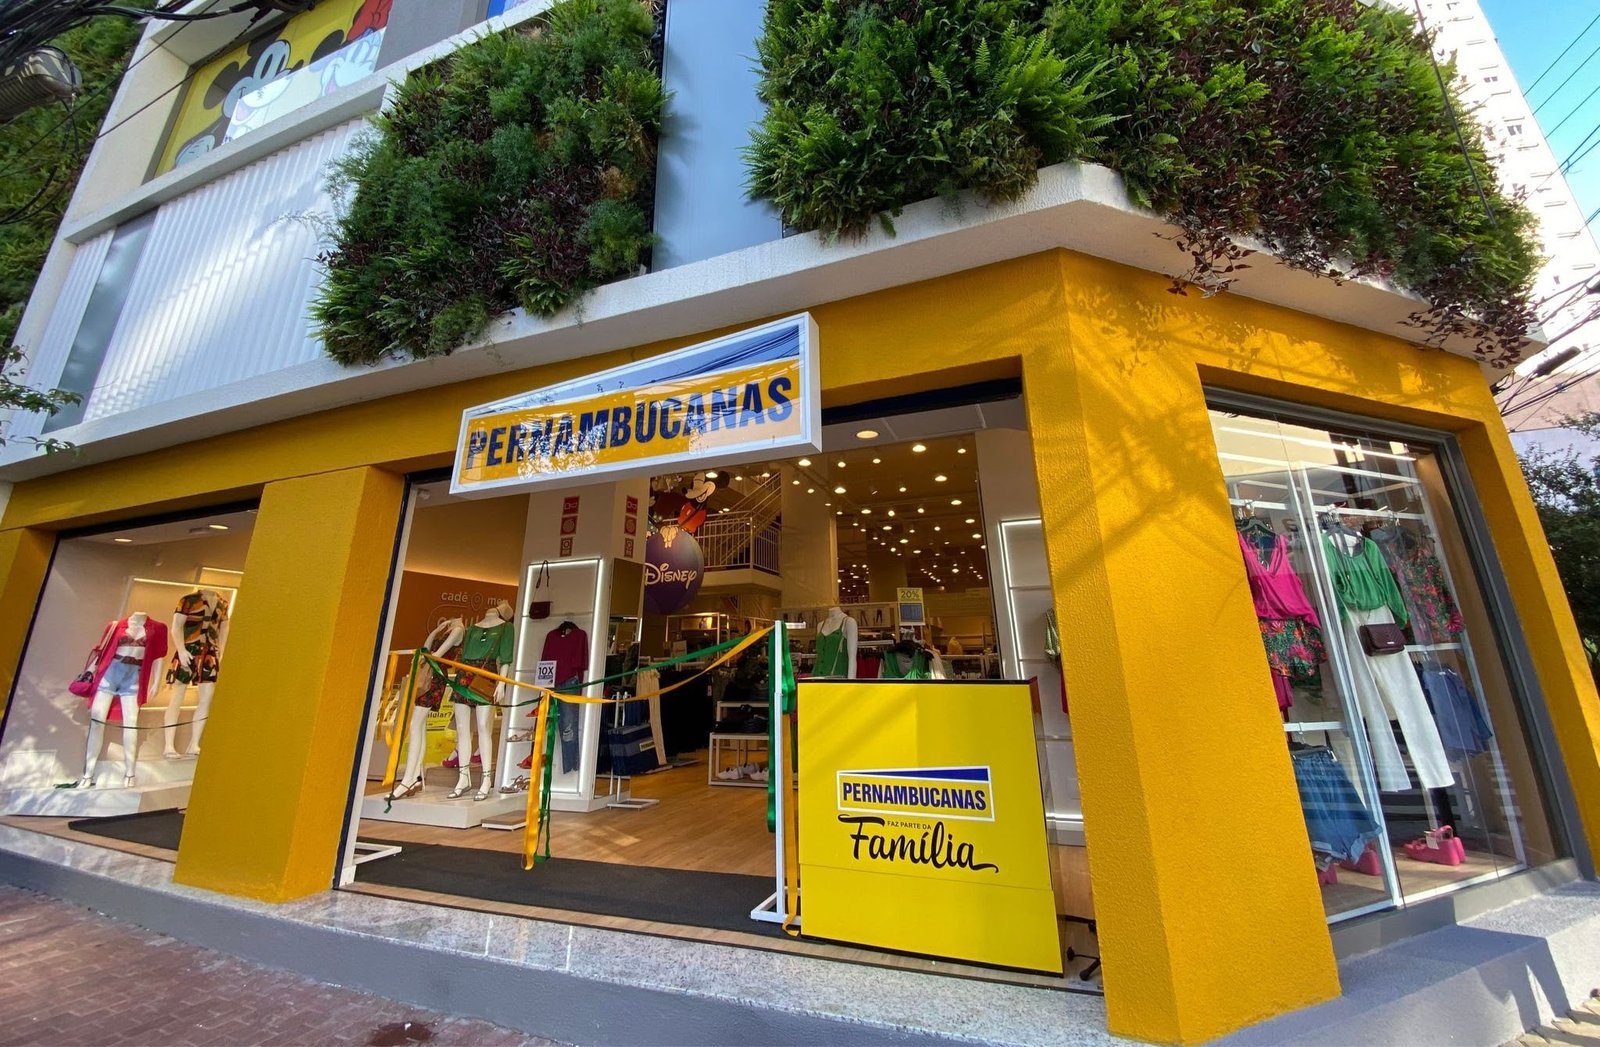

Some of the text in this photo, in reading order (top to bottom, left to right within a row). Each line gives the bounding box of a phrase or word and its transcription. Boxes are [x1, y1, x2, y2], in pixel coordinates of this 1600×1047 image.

[465, 377, 793, 470] PERNAMBUCANAS
[901, 590, 920, 598] 20%
[843, 782, 987, 811] PERNAMBUCANAS
[900, 822, 921, 830] PARTE
[838, 813, 999, 874] Família
